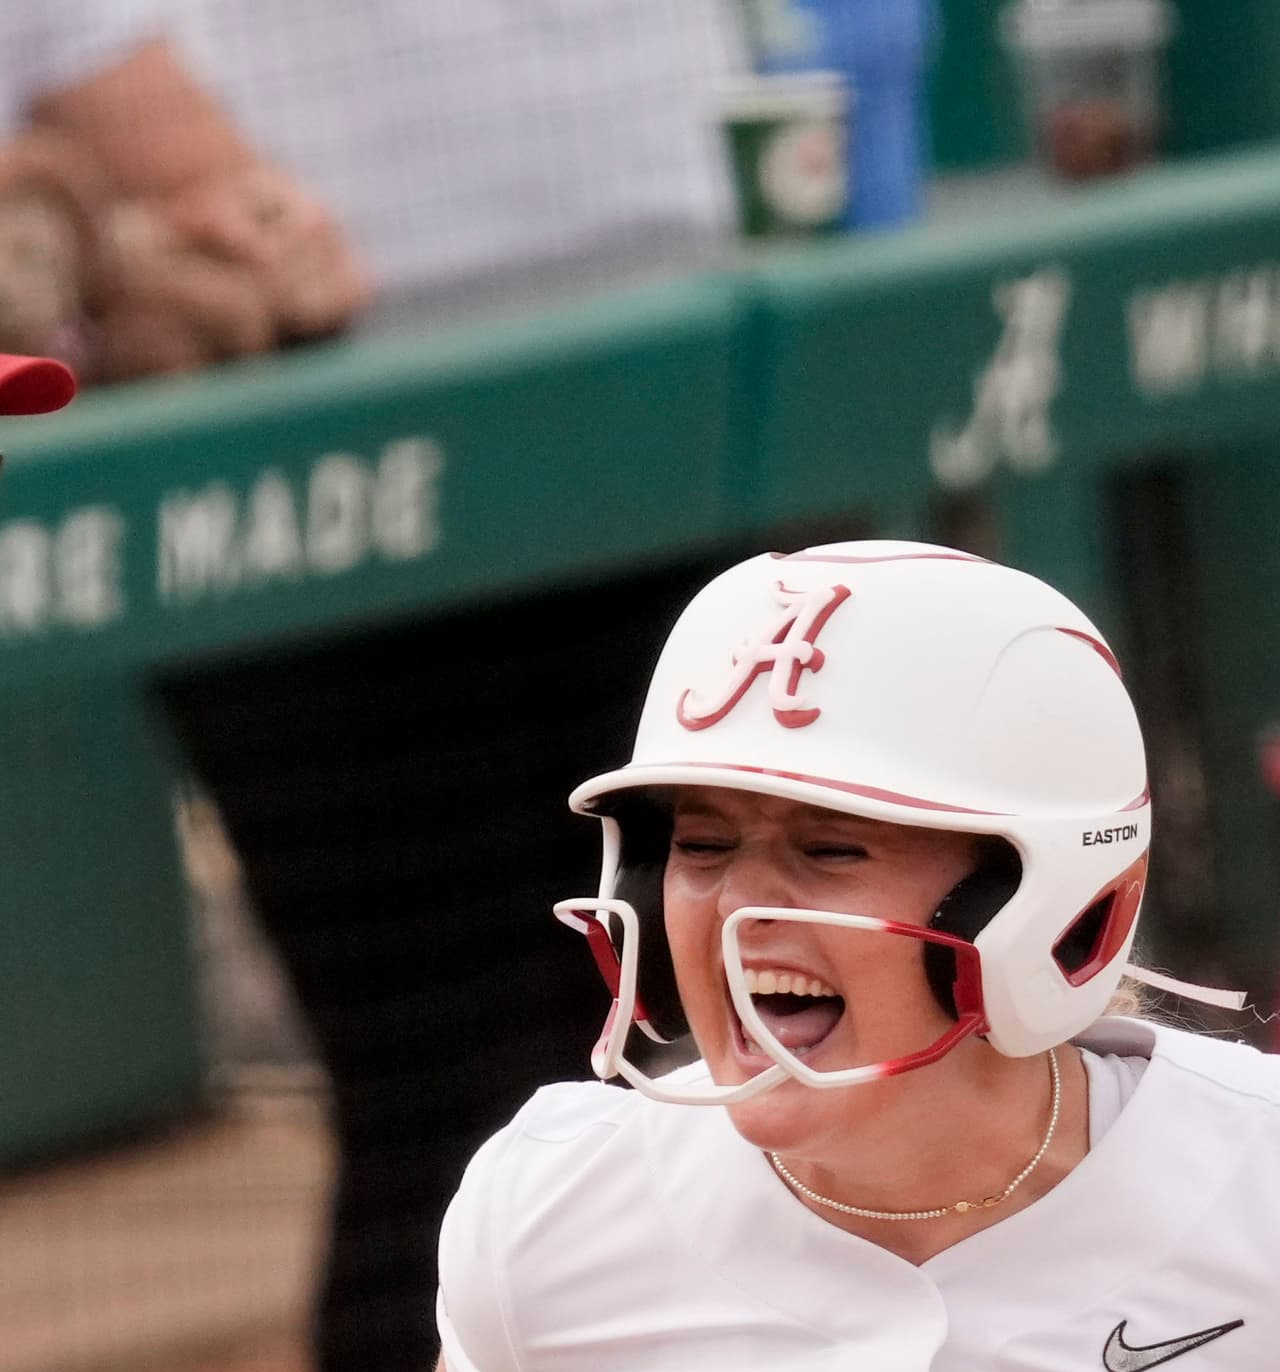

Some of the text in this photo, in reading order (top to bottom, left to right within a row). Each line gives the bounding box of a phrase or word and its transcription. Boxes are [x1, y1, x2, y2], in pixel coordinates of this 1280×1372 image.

[157, 436, 445, 608] MADE
[677, 579, 852, 732] A
[1082, 822, 1138, 847] EASTON
